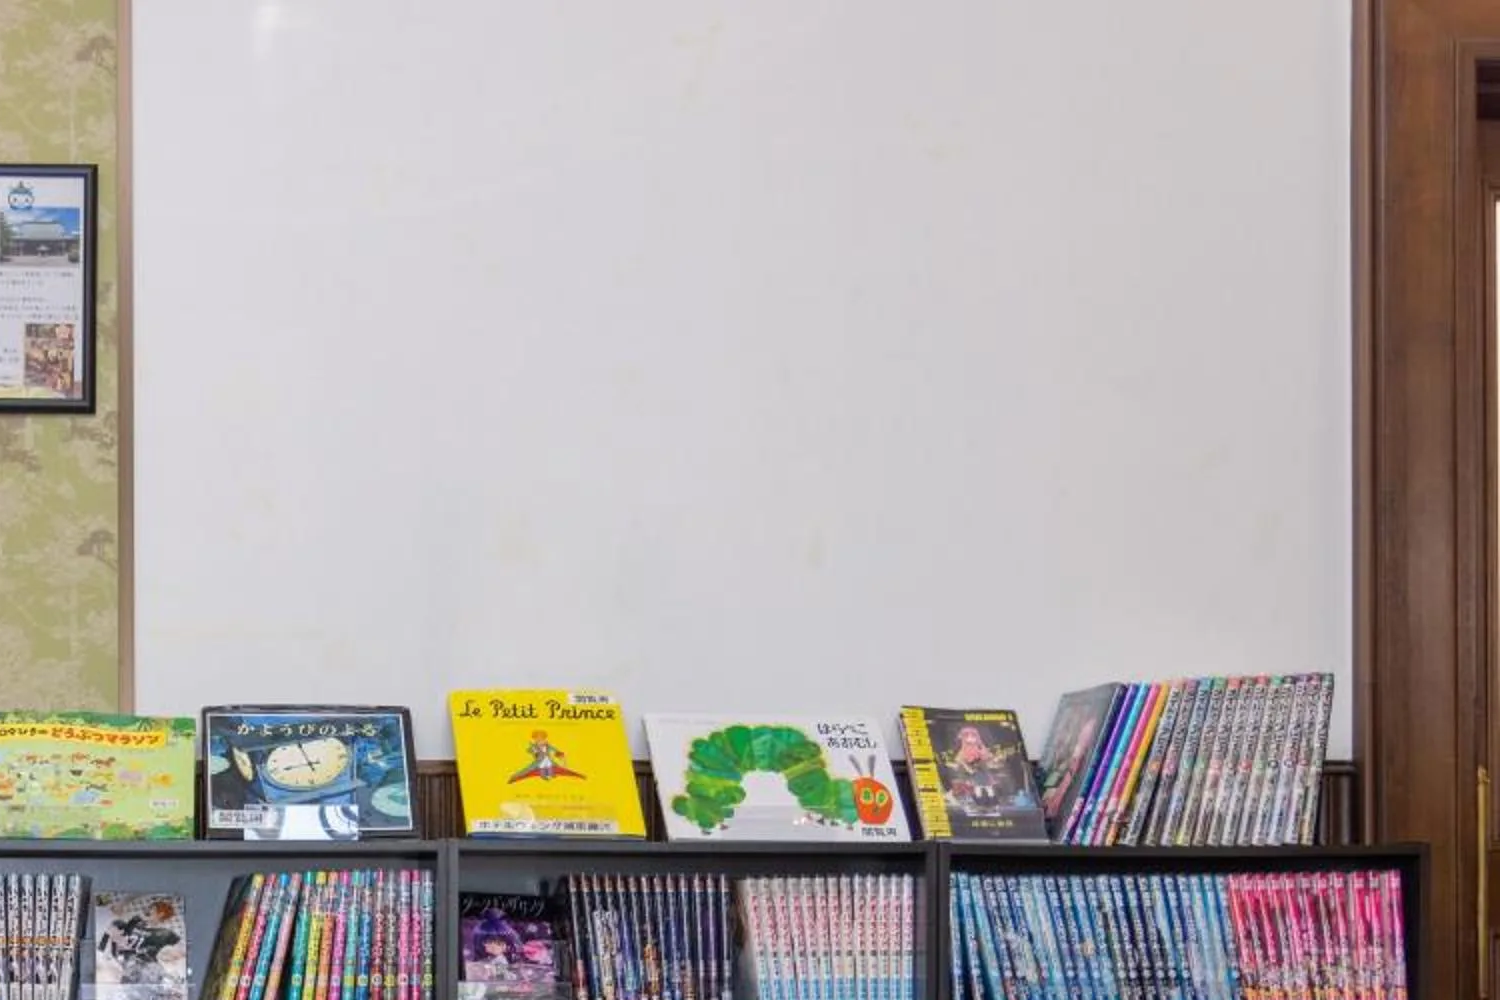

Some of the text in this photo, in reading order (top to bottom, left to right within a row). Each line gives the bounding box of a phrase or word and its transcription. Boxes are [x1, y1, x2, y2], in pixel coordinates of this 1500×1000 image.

[459, 699, 616, 721] Le Petit Prince
[236, 723, 378, 737] かようびのよる
[817, 723, 869, 735] はらぺこ
[826, 736, 878, 749] あおむし
